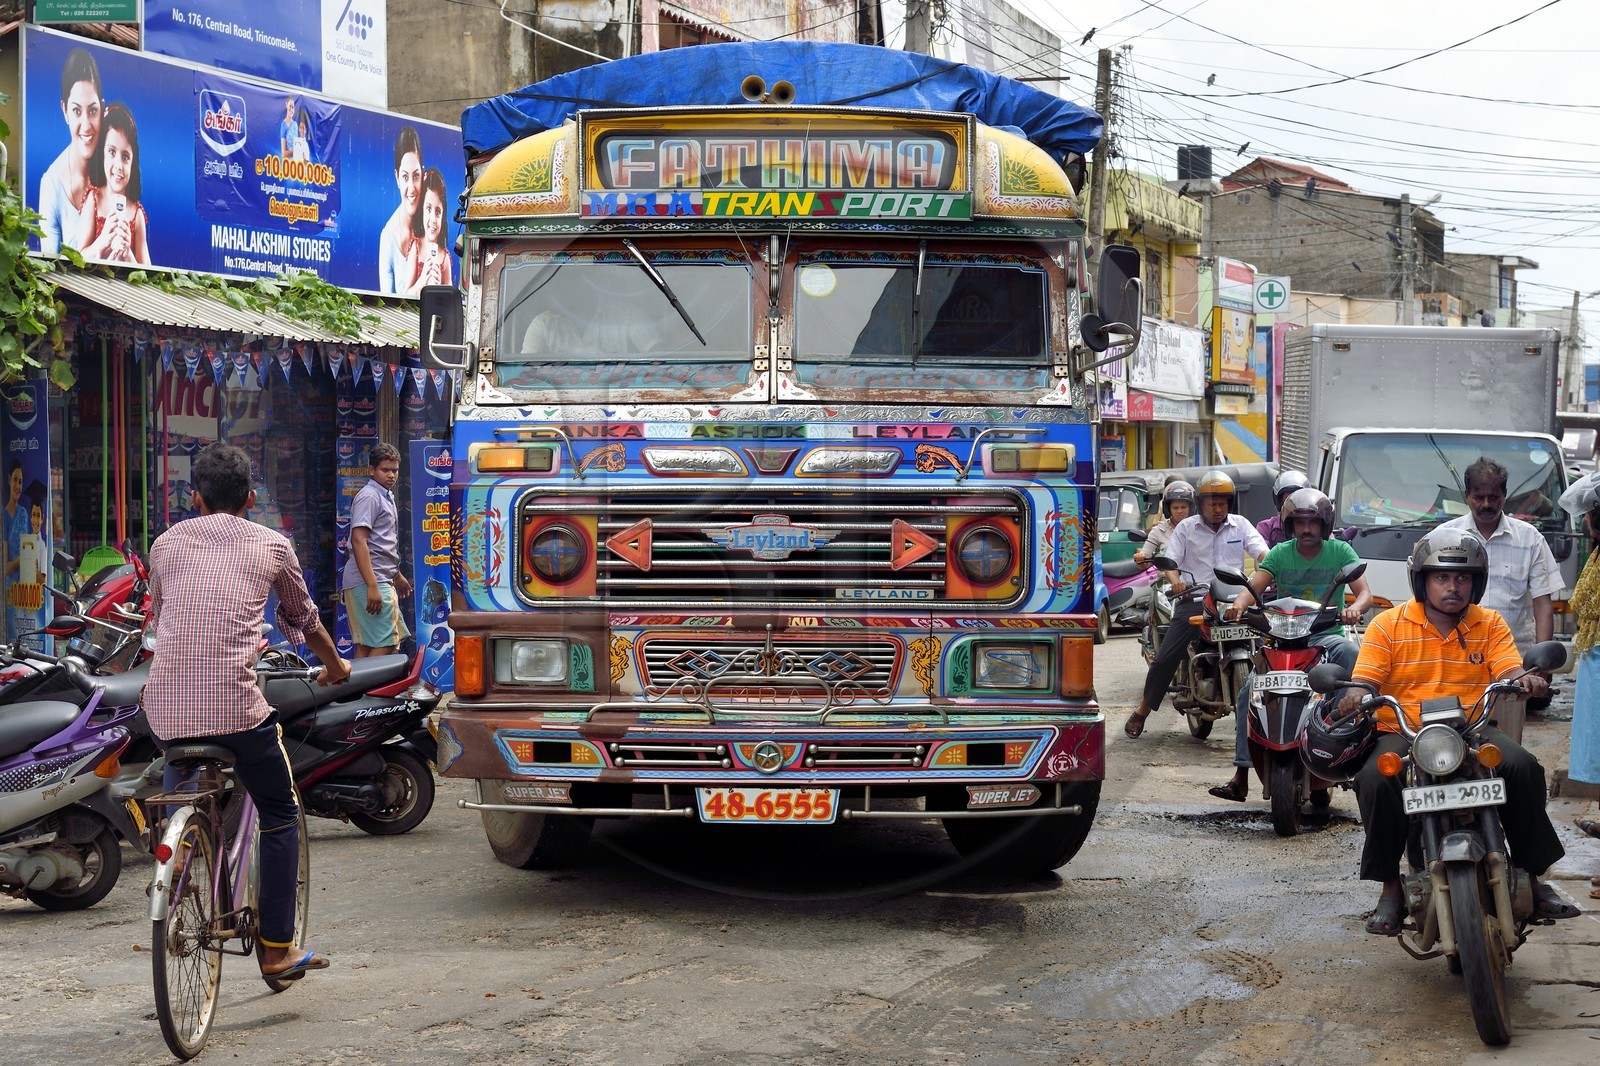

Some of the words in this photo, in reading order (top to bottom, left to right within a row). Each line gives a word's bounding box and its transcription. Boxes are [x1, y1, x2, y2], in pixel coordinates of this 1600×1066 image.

[172, 8, 186, 23] No.
[187, 12, 204, 29] 176,
[205, 17, 232, 35] Central
[233, 24, 254, 42] Road,
[254, 30, 298, 52] Trincomalee.
[325, 50, 337, 63] One
[337, 54, 357, 71] Country.
[358, 60, 369, 72] One
[369, 64, 384, 76] Voice.
[606, 138, 945, 189] FATHIMA
[211, 224, 291, 258] MAHALAKSHMI
[292, 236, 331, 262] STORES
[1129, 408, 1152, 418] airtel
[530, 425, 643, 438] LANKA
[691, 425, 804, 439] ASHOK
[852, 425, 1016, 439] LEYLAND
[733, 529, 809, 551] Leyland
[842, 590, 929, 598] LEYLAND
[354, 703, 406, 721] Pleasure
[31, 767, 69, 782] Scooty
[504, 785, 544, 800] SUPER
[546, 787, 567, 800] JET
[970, 790, 1009, 806] SUPER
[1011, 789, 1036, 801] JET
[704, 790, 832, 821] 48-6555
